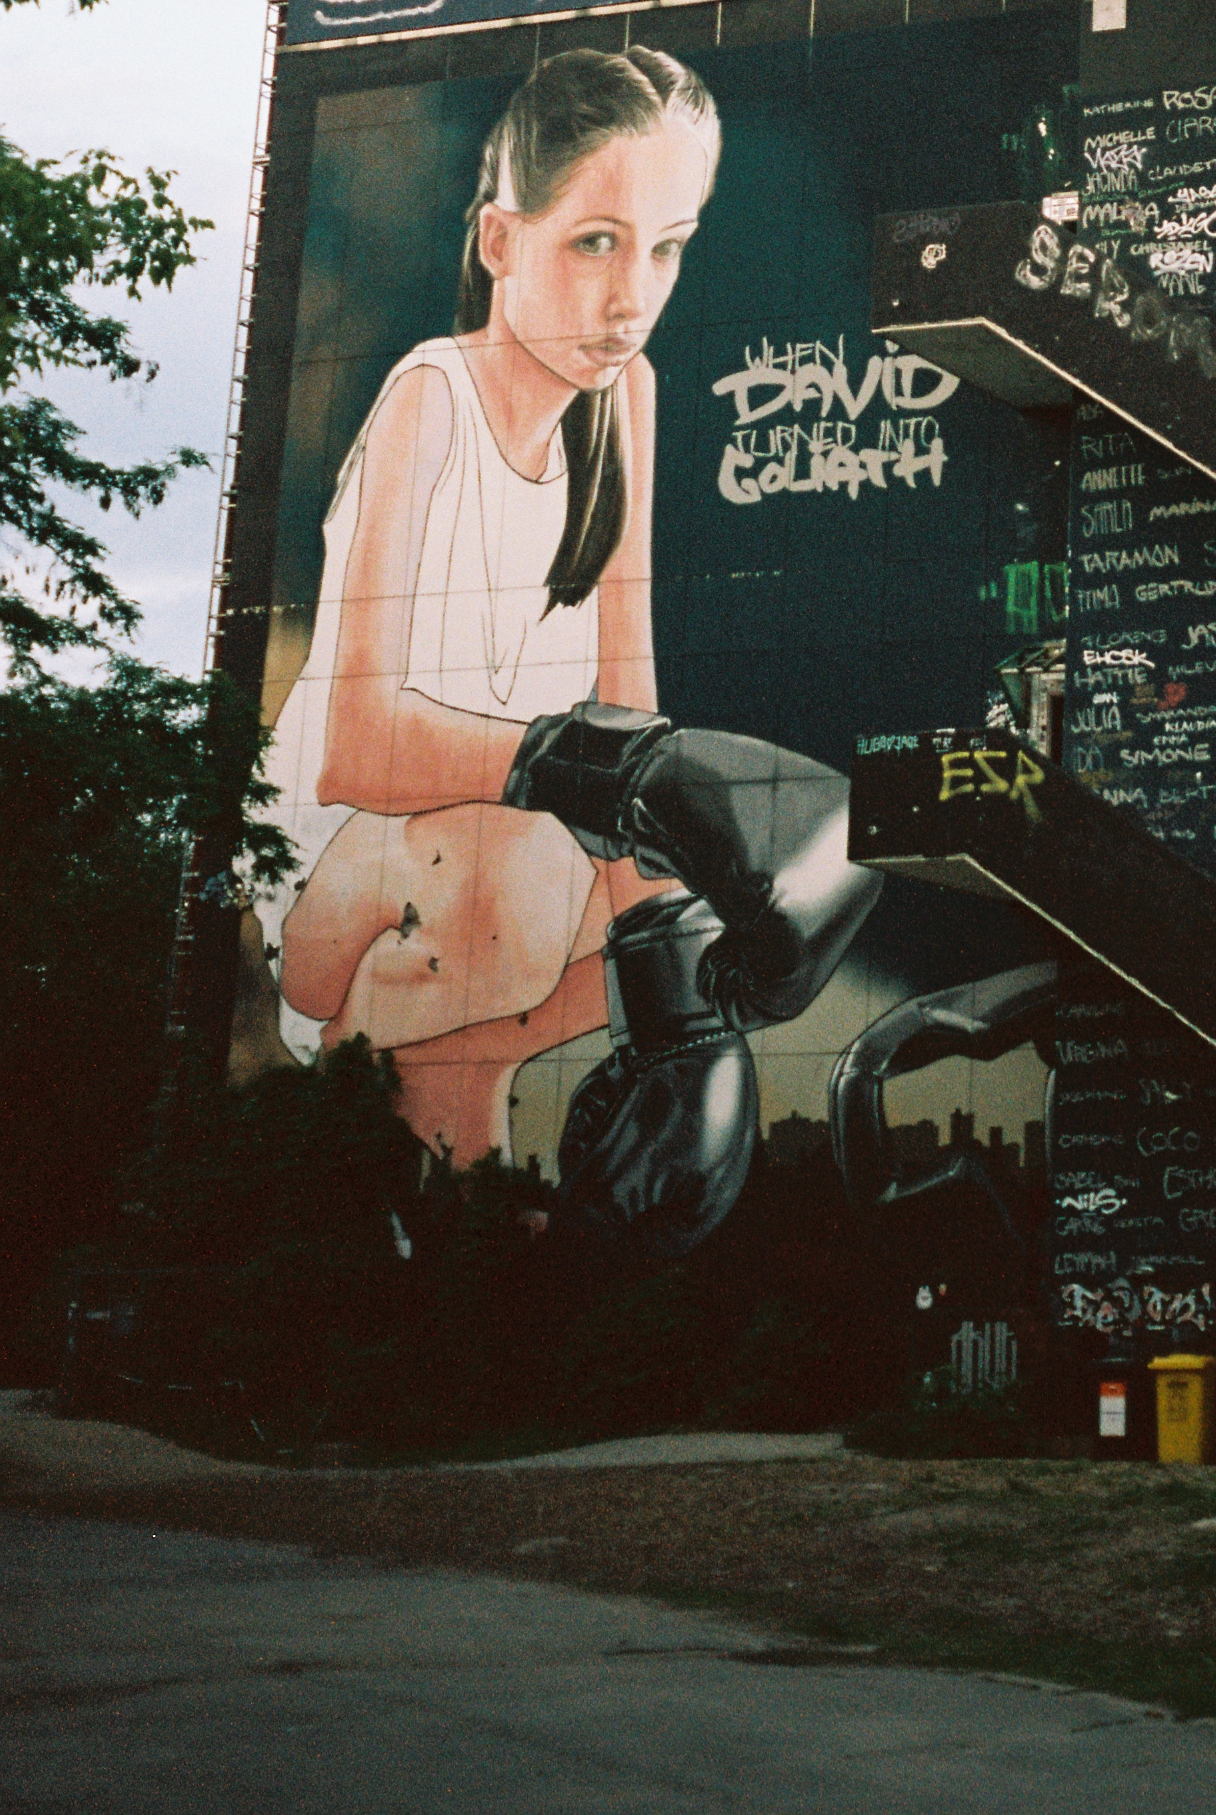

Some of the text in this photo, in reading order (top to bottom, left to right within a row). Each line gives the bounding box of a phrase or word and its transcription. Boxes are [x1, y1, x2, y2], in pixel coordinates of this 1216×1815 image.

[1084, 126, 1156, 151] MICHELLE
[745, 333, 844, 371] WHEN
[732, 415, 940, 457] TURNED INTO
[1070, 705, 1122, 733] JULIA
[1120, 742, 1211, 768] SIMONE
